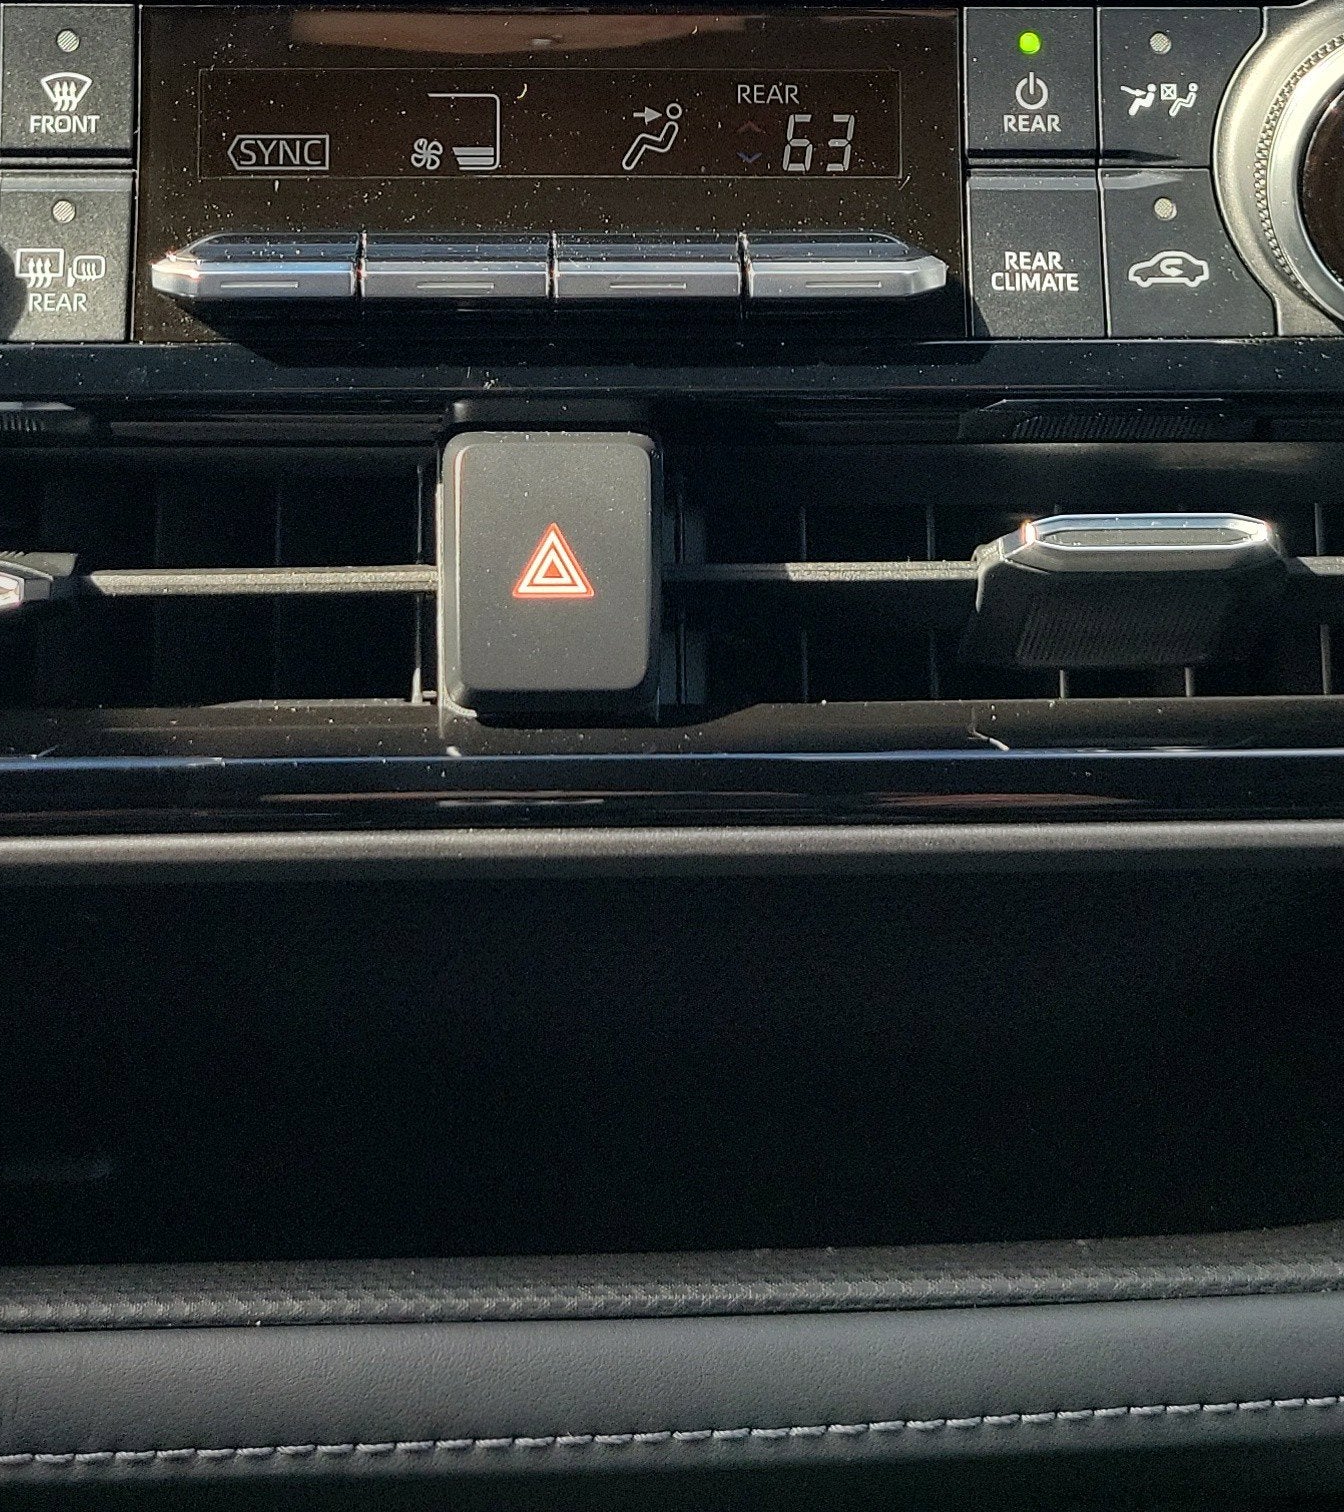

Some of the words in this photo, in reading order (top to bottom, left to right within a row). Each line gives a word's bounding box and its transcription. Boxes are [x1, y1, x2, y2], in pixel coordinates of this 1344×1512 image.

[736, 84, 799, 105] REAR
[29, 114, 99, 135] FRONT
[1002, 113, 1061, 133] REAR
[240, 138, 322, 167] SYNC
[781, 113, 855, 172] 63
[1004, 252, 1061, 272] REAR
[991, 272, 1079, 293] CLIMATE
[28, 291, 88, 313] REAR
